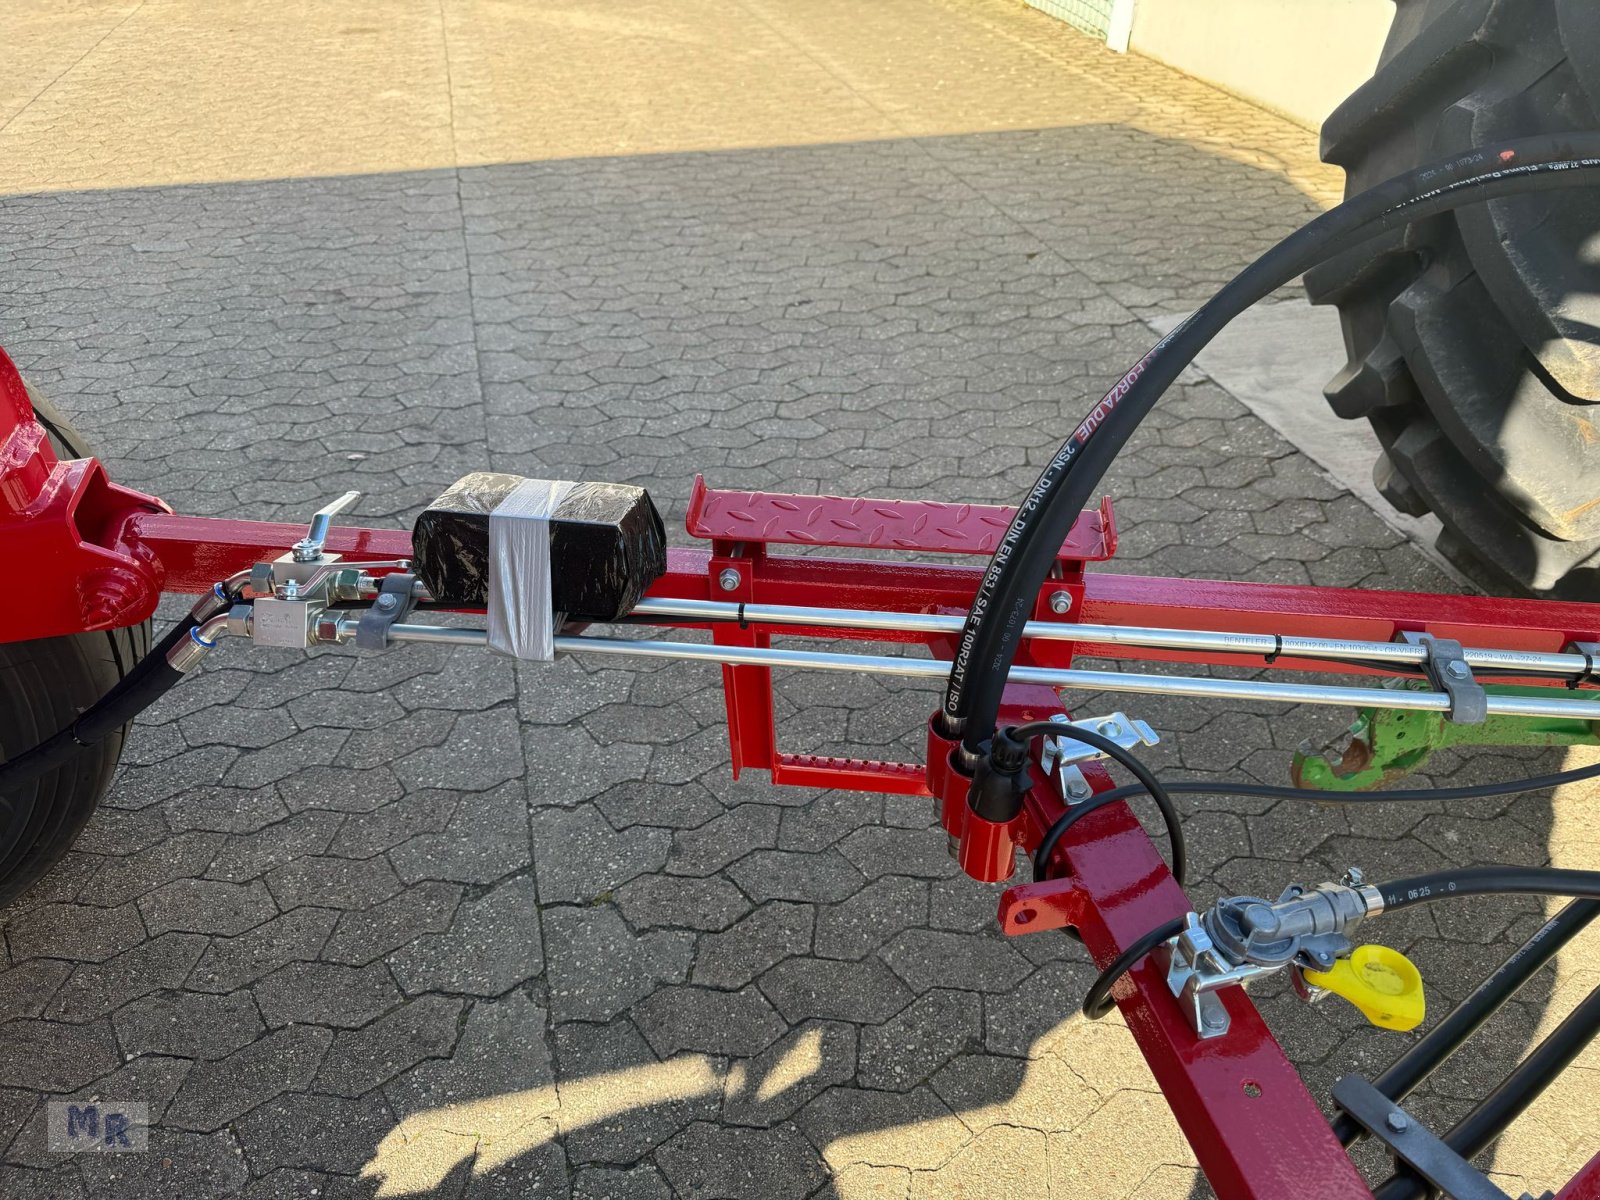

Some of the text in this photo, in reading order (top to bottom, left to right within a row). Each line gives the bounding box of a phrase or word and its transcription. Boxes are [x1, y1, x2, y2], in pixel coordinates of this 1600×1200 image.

[1103, 363, 1145, 410] FORZA
[1077, 408, 1106, 441] DUE
[1052, 445, 1075, 471] 2SN
[1025, 480, 1052, 511] DN12
[1006, 520, 1026, 543] DIN
[996, 544, 1012, 565] EN
[985, 566, 1002, 588] 853
[970, 597, 987, 626] SAE
[953, 629, 977, 682] 100R2AT
[949, 689, 960, 712] ISO
